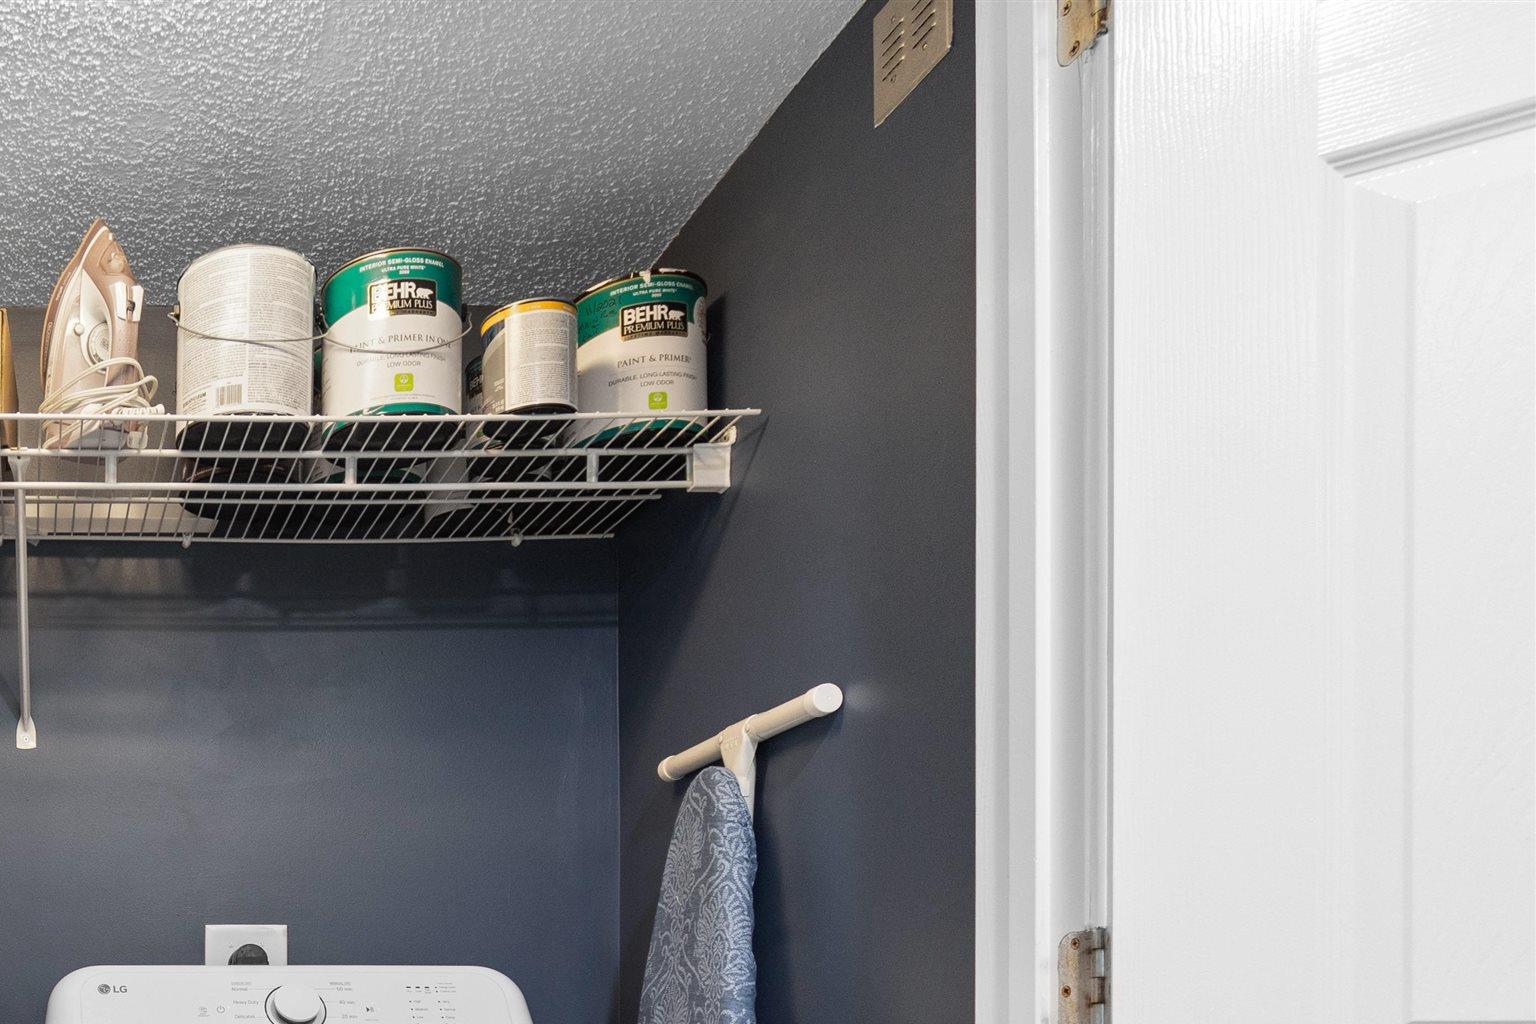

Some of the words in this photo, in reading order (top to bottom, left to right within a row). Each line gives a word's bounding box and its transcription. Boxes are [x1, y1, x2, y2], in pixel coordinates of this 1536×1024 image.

[359, 260, 386, 273] INTERIOR
[387, 257, 424, 265] SEMI-GLOSS
[425, 258, 445, 268] ENAMEL
[609, 284, 639, 297] INTERIOR
[639, 281, 676, 289] SEMI-GLOSS
[414, 299, 433, 309] PLUS
[624, 304, 669, 326] BEHR
[624, 321, 665, 335] PREMIUM
[666, 321, 685, 331] PLUS
[388, 333, 423, 343] PRIMER
[426, 334, 436, 343] IN
[617, 355, 646, 369] PAINT
[648, 354, 657, 362] &
[113, 985, 128, 994] LG
